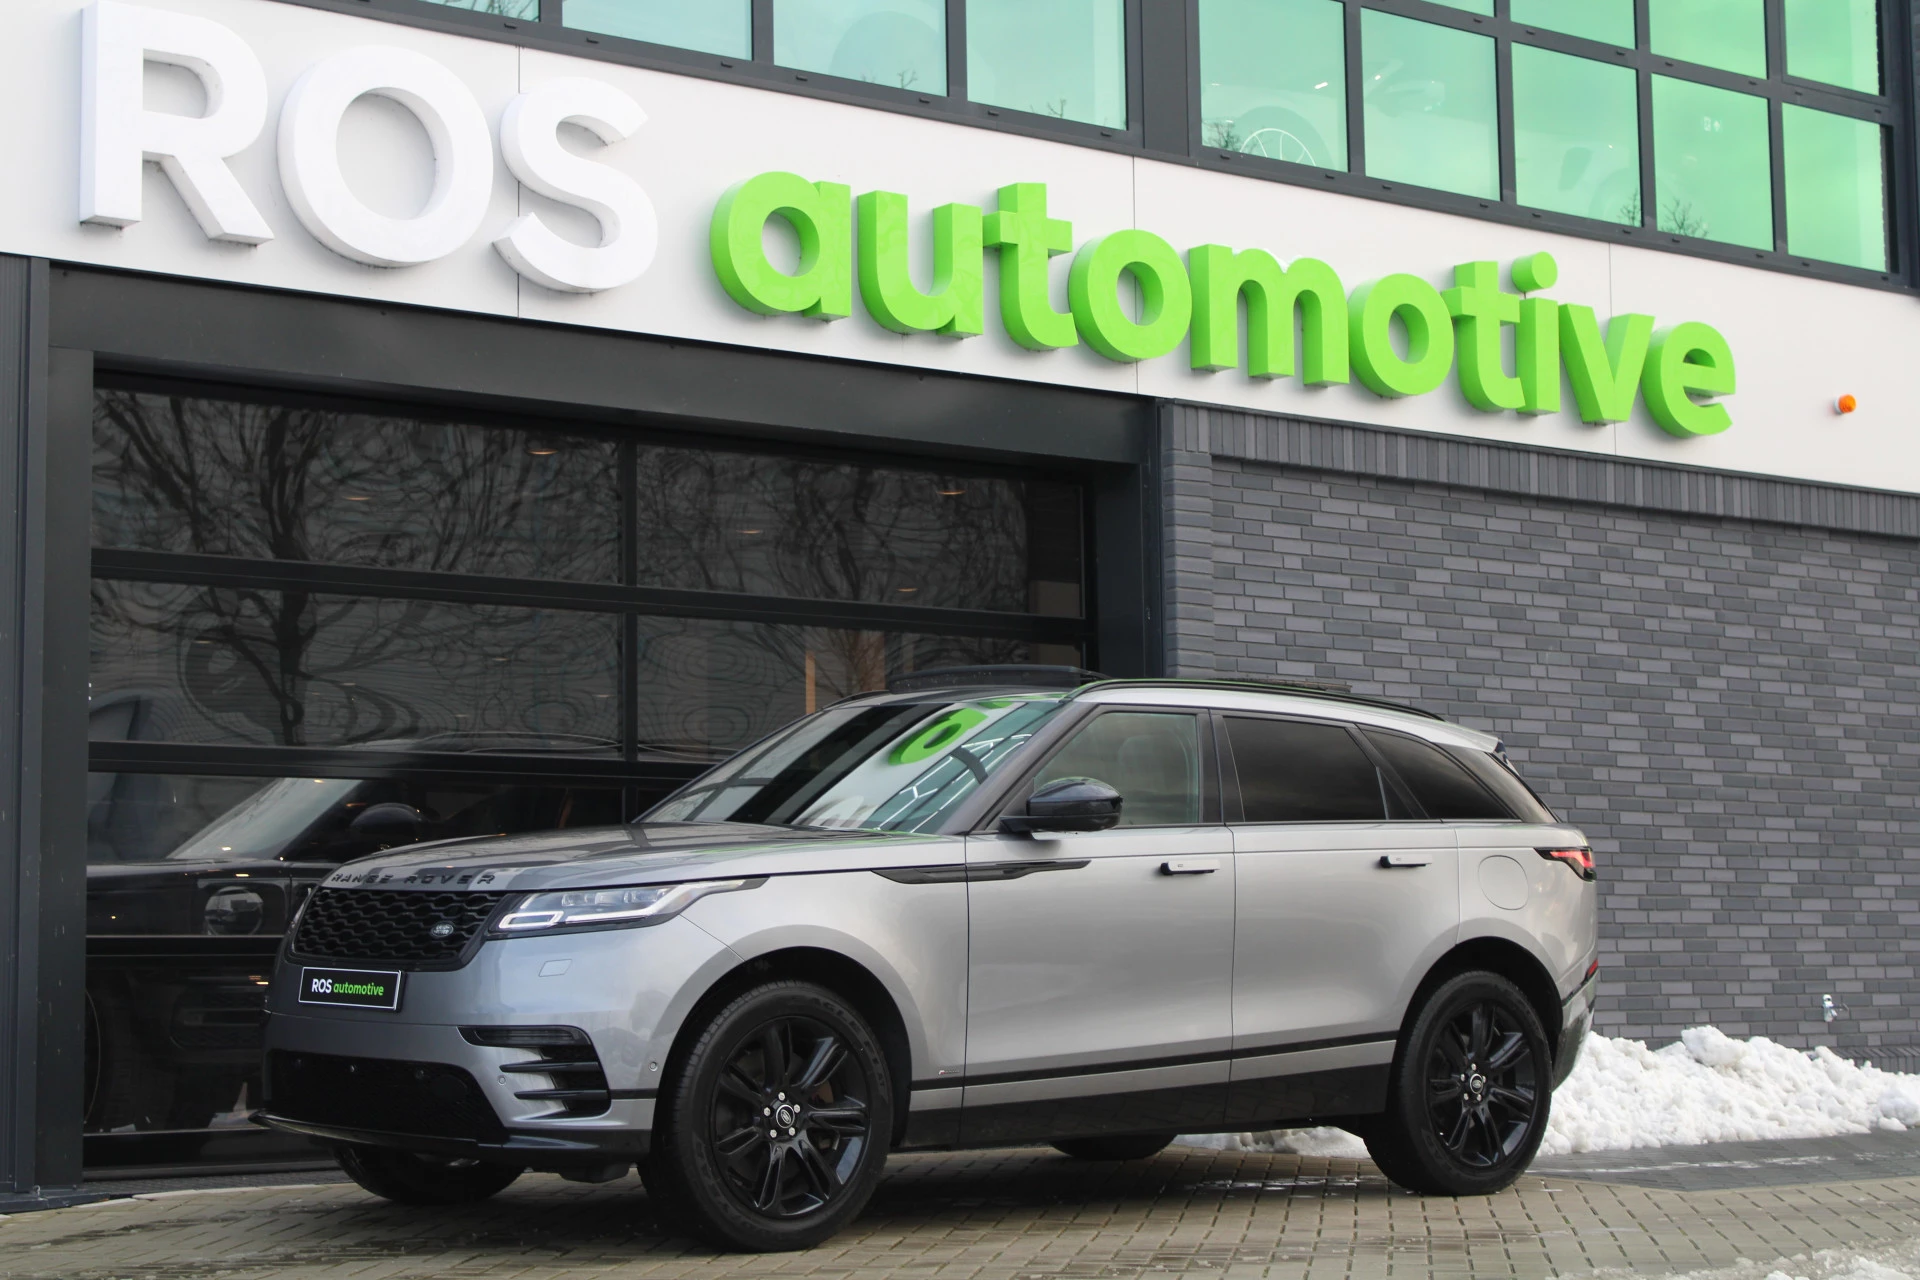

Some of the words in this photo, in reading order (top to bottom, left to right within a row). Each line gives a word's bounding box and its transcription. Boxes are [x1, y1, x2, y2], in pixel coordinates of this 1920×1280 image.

[79, 0, 658, 293] ROS
[710, 171, 1736, 438] automotive
[331, 873, 394, 884] RANGE
[404, 873, 496, 885] ROVER
[311, 978, 333, 994] ROS
[333, 982, 385, 996] automotive
